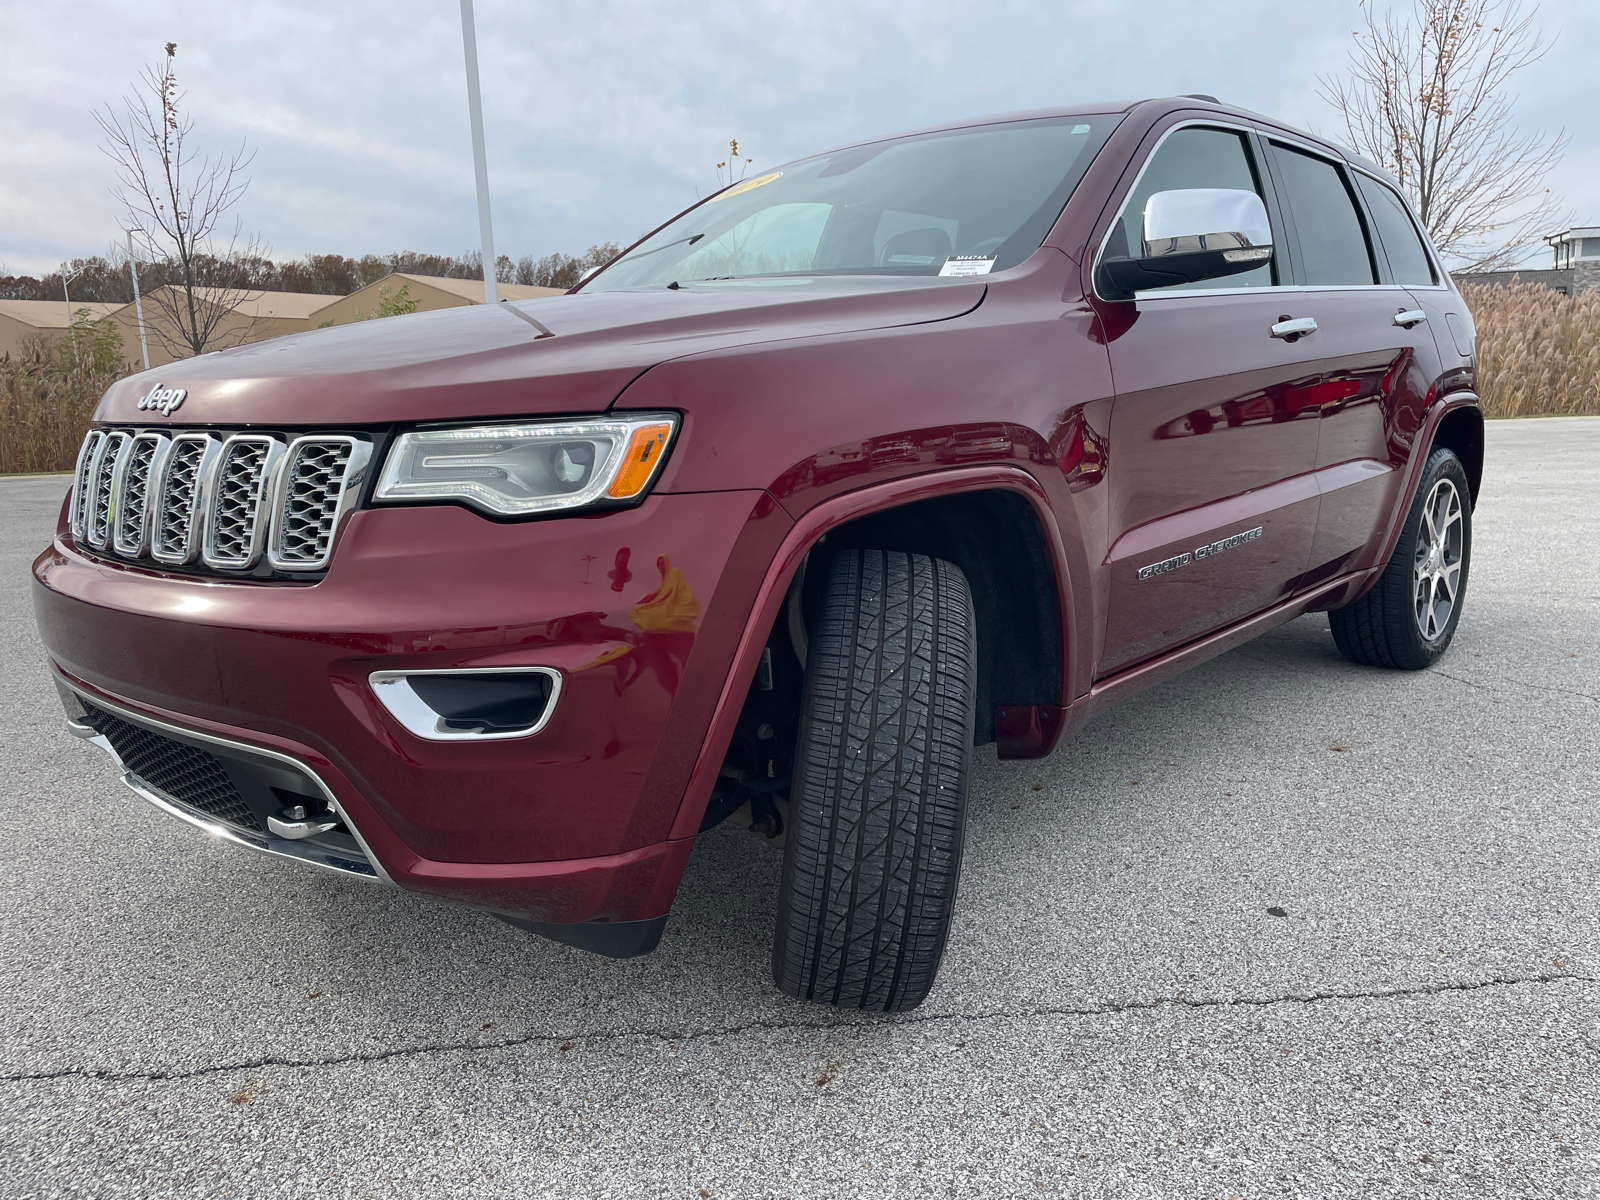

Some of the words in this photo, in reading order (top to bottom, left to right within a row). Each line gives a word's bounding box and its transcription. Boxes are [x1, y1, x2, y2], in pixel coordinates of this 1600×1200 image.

[137, 383, 187, 417] Jeep
[1137, 552, 1192, 581] GRAND
[1193, 526, 1263, 561] CHEROKEE
